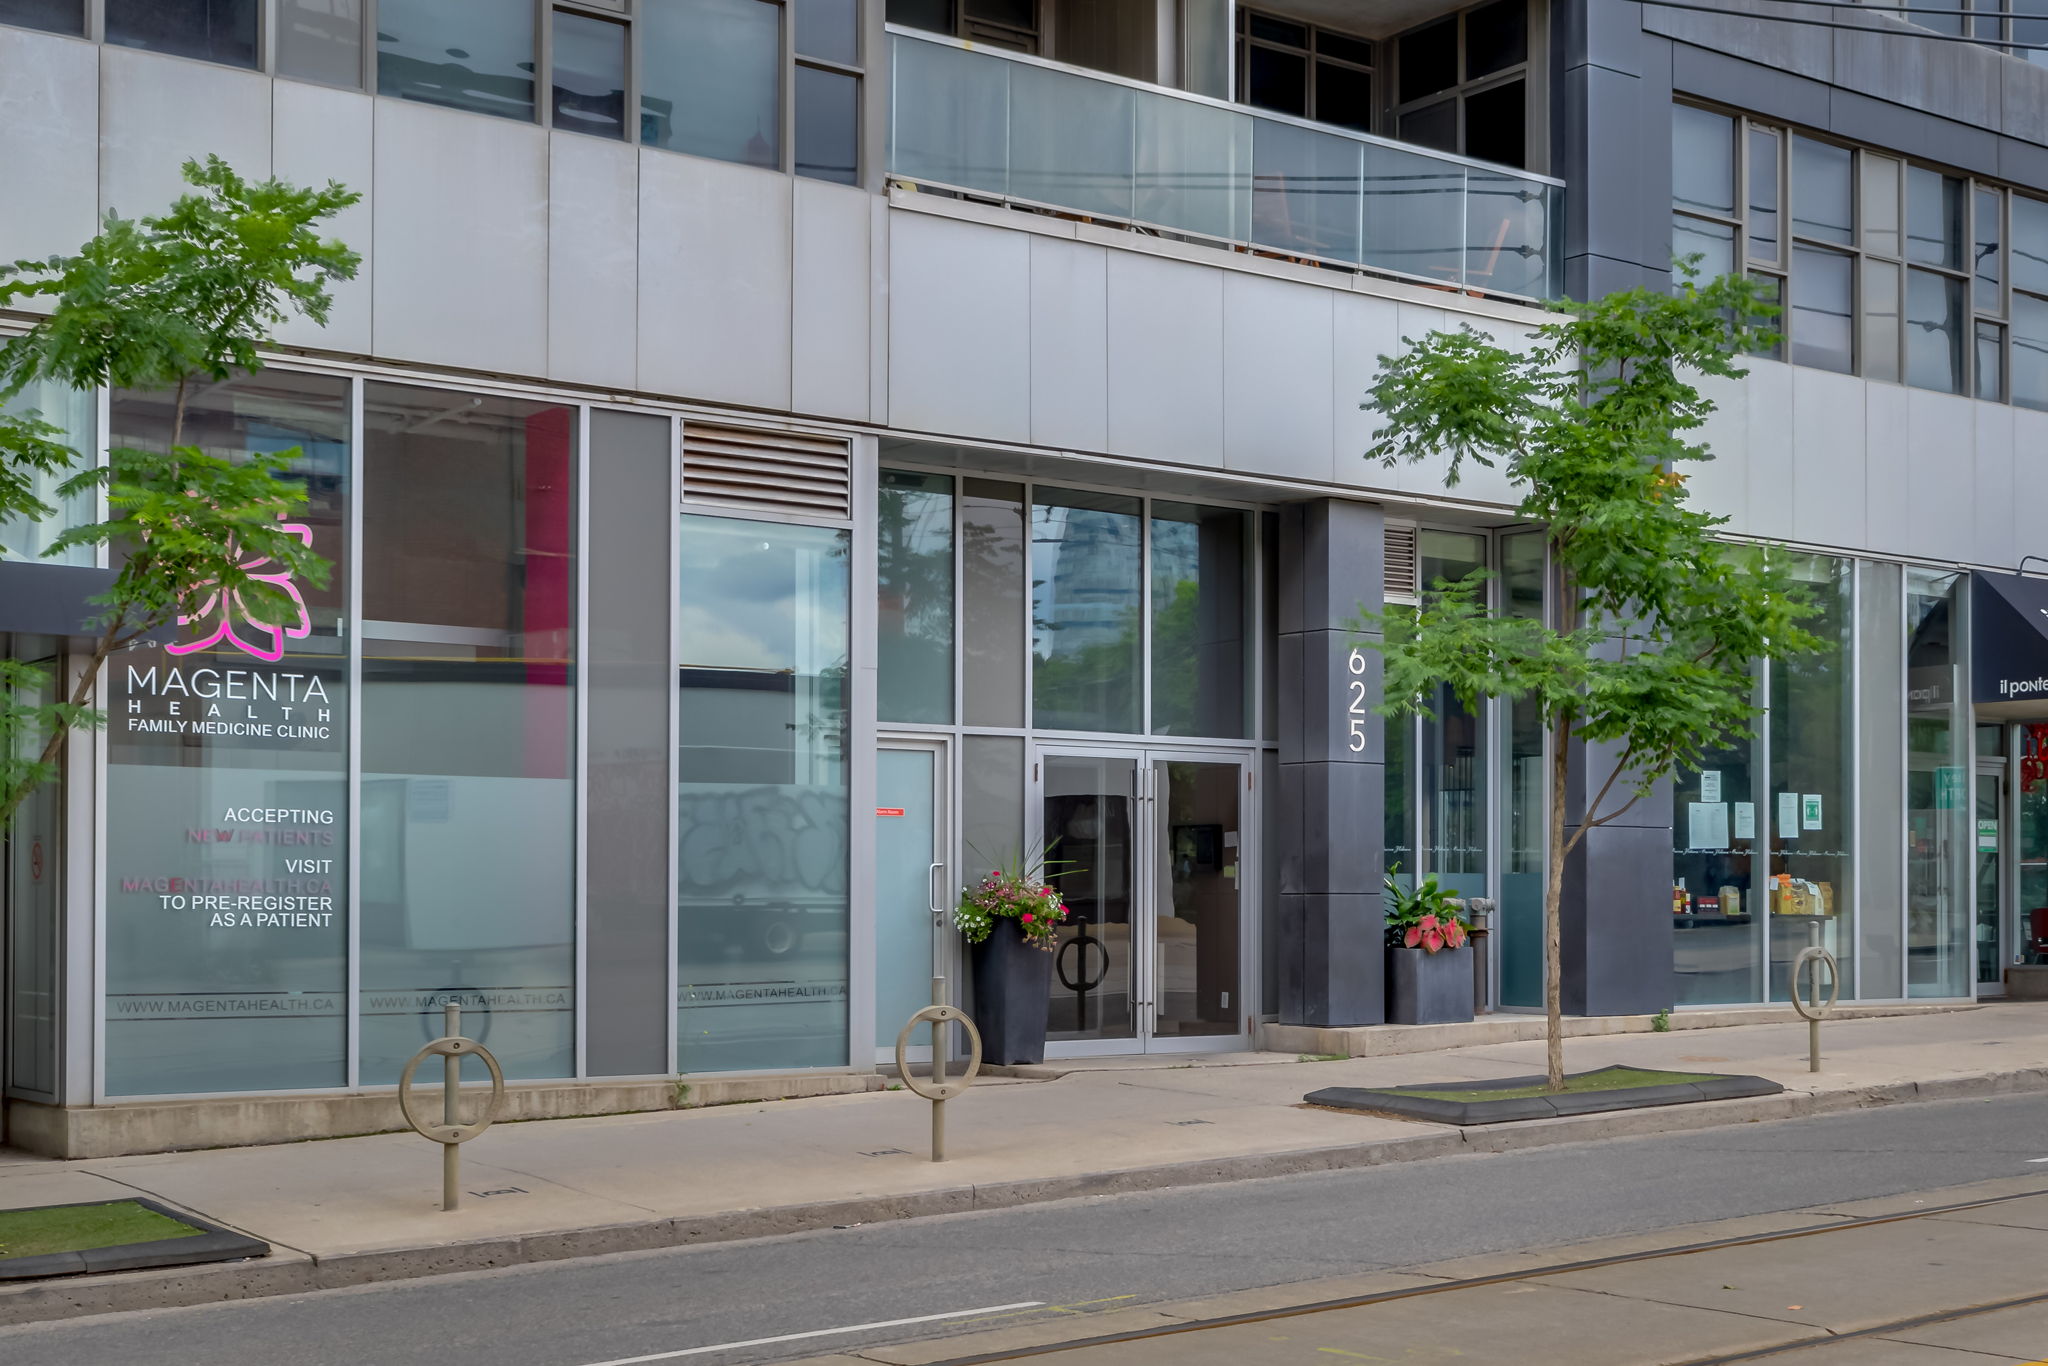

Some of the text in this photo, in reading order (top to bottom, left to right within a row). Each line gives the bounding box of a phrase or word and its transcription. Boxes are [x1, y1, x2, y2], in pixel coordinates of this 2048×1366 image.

[127, 665, 329, 704] MAGENTA
[2000, 679, 2008, 694] il
[1348, 647, 1366, 752] 625
[128, 700, 330, 722] HEALTH
[128, 718, 330, 739] FAMILY MEDICINE CLINIC
[224, 807, 334, 824] ACCEPTING
[1978, 820, 1997, 831] OPEN
[186, 828, 334, 846] NEW PATIENTS
[285, 859, 332, 874] VISIT
[160, 895, 333, 911] TO PRE-REGISTER
[210, 912, 333, 927] AS A PATIENT
[117, 998, 335, 1014] WWW.MAGENTAHEALTH.CA
